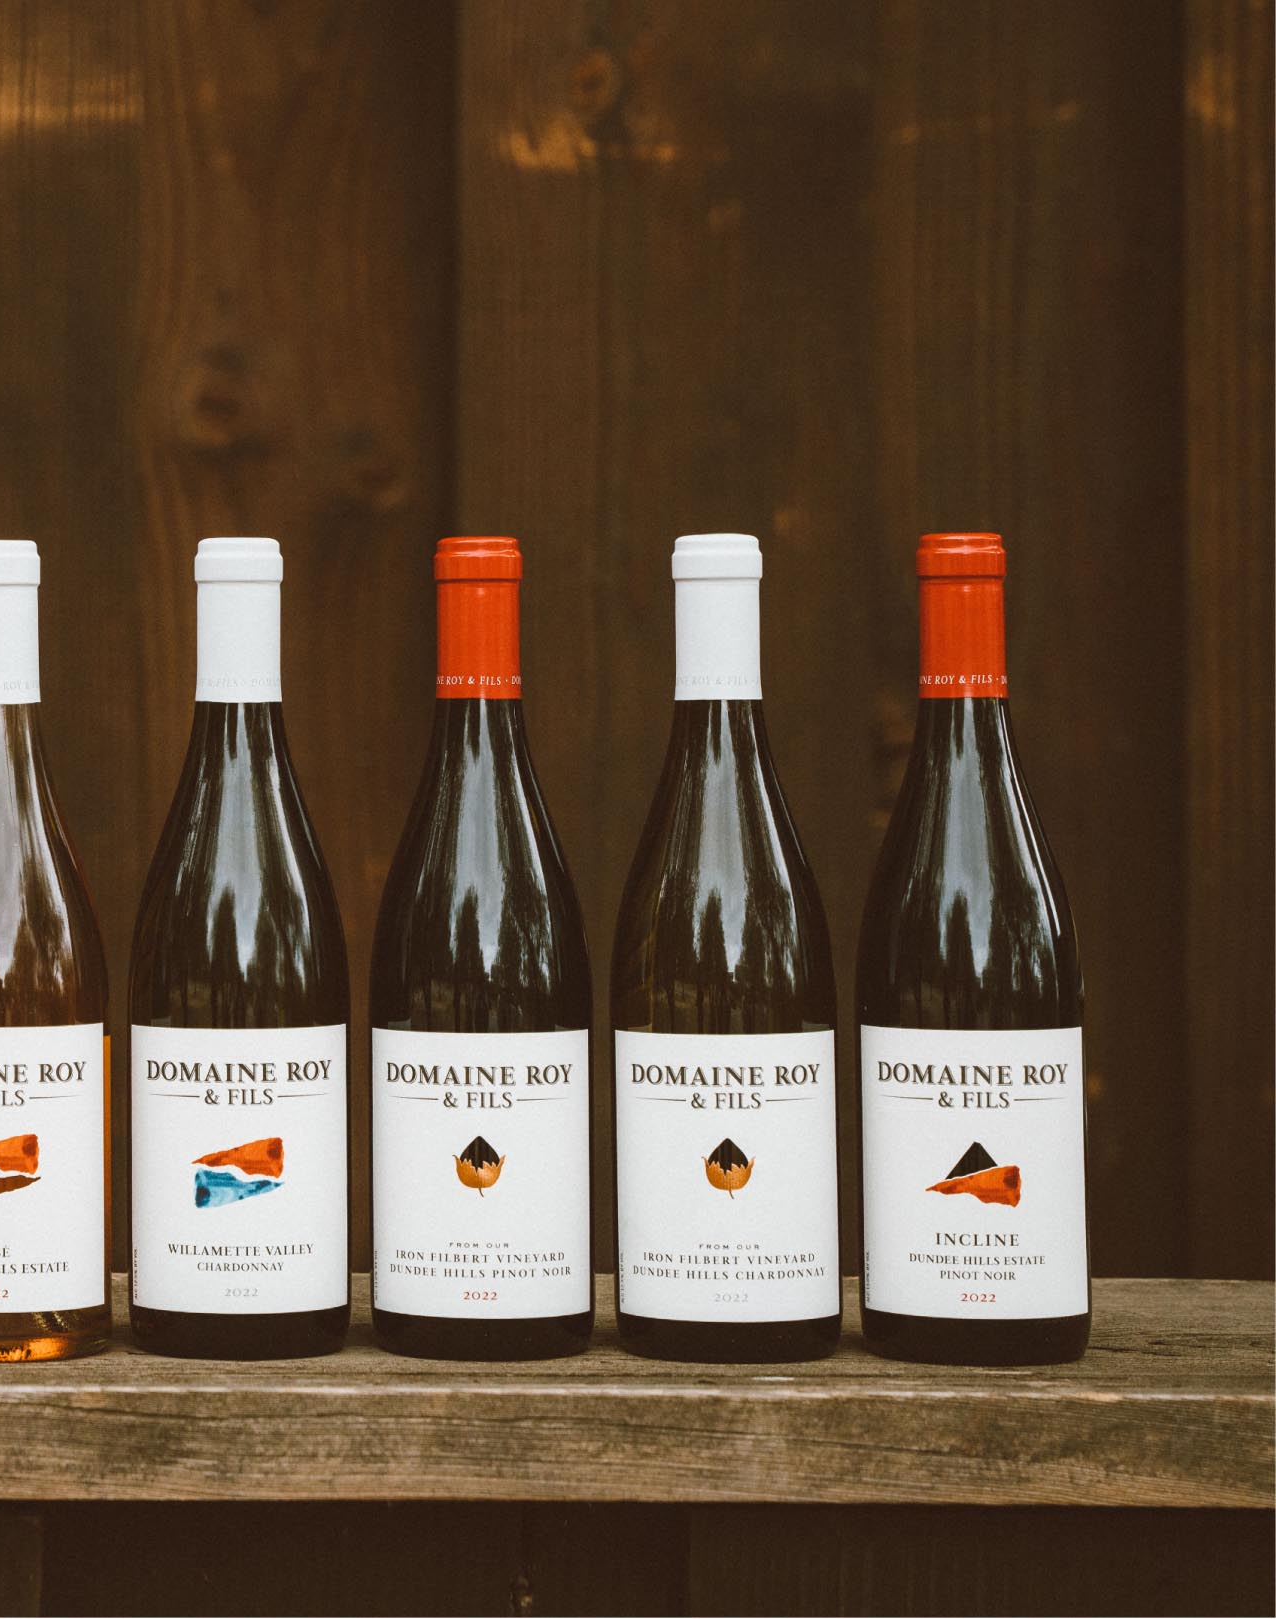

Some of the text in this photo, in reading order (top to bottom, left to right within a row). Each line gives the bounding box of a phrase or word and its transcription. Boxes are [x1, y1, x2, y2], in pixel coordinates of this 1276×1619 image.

[446, 676, 463, 685] ROY
[480, 676, 501, 686] FILS
[935, 675, 954, 684] ROY
[958, 676, 966, 684] &
[971, 675, 992, 684] FILS
[38, 1061, 86, 1084] ROY
[146, 1060, 332, 1083] DOMAINE ROY
[386, 1061, 573, 1087] DOMAINE ROY
[631, 1063, 820, 1087] DOMAINE ROY
[876, 1061, 1068, 1086] DOMAINE ROY
[204, 1088, 273, 1105] & FILS
[443, 1092, 513, 1109] & FILS
[691, 1092, 761, 1109] & FILS
[938, 1091, 1010, 1109] & FILS
[936, 1232, 1019, 1246] INCLINE
[168, 1243, 313, 1256] WILLAMETTE VALLEY
[396, 1249, 564, 1263] IRON FILBERT VINEYARD
[644, 1252, 814, 1264] IRON FILBERT VINEYARD
[910, 1253, 1045, 1265] DUNDEE HILLS ESTATE
[22, 1262, 68, 1274] ESTATE
[197, 1262, 283, 1272] CHARDONNAY
[390, 1264, 571, 1278] DUNDEE HILLS PINOT NOIR
[633, 1265, 825, 1280] DUNDEE HILLS CHARDONNAY
[940, 1270, 1016, 1280] PINOT NOIR
[464, 1291, 497, 1300] 2022
[716, 1294, 748, 1302] 2022
[961, 1293, 996, 1302] 2022
